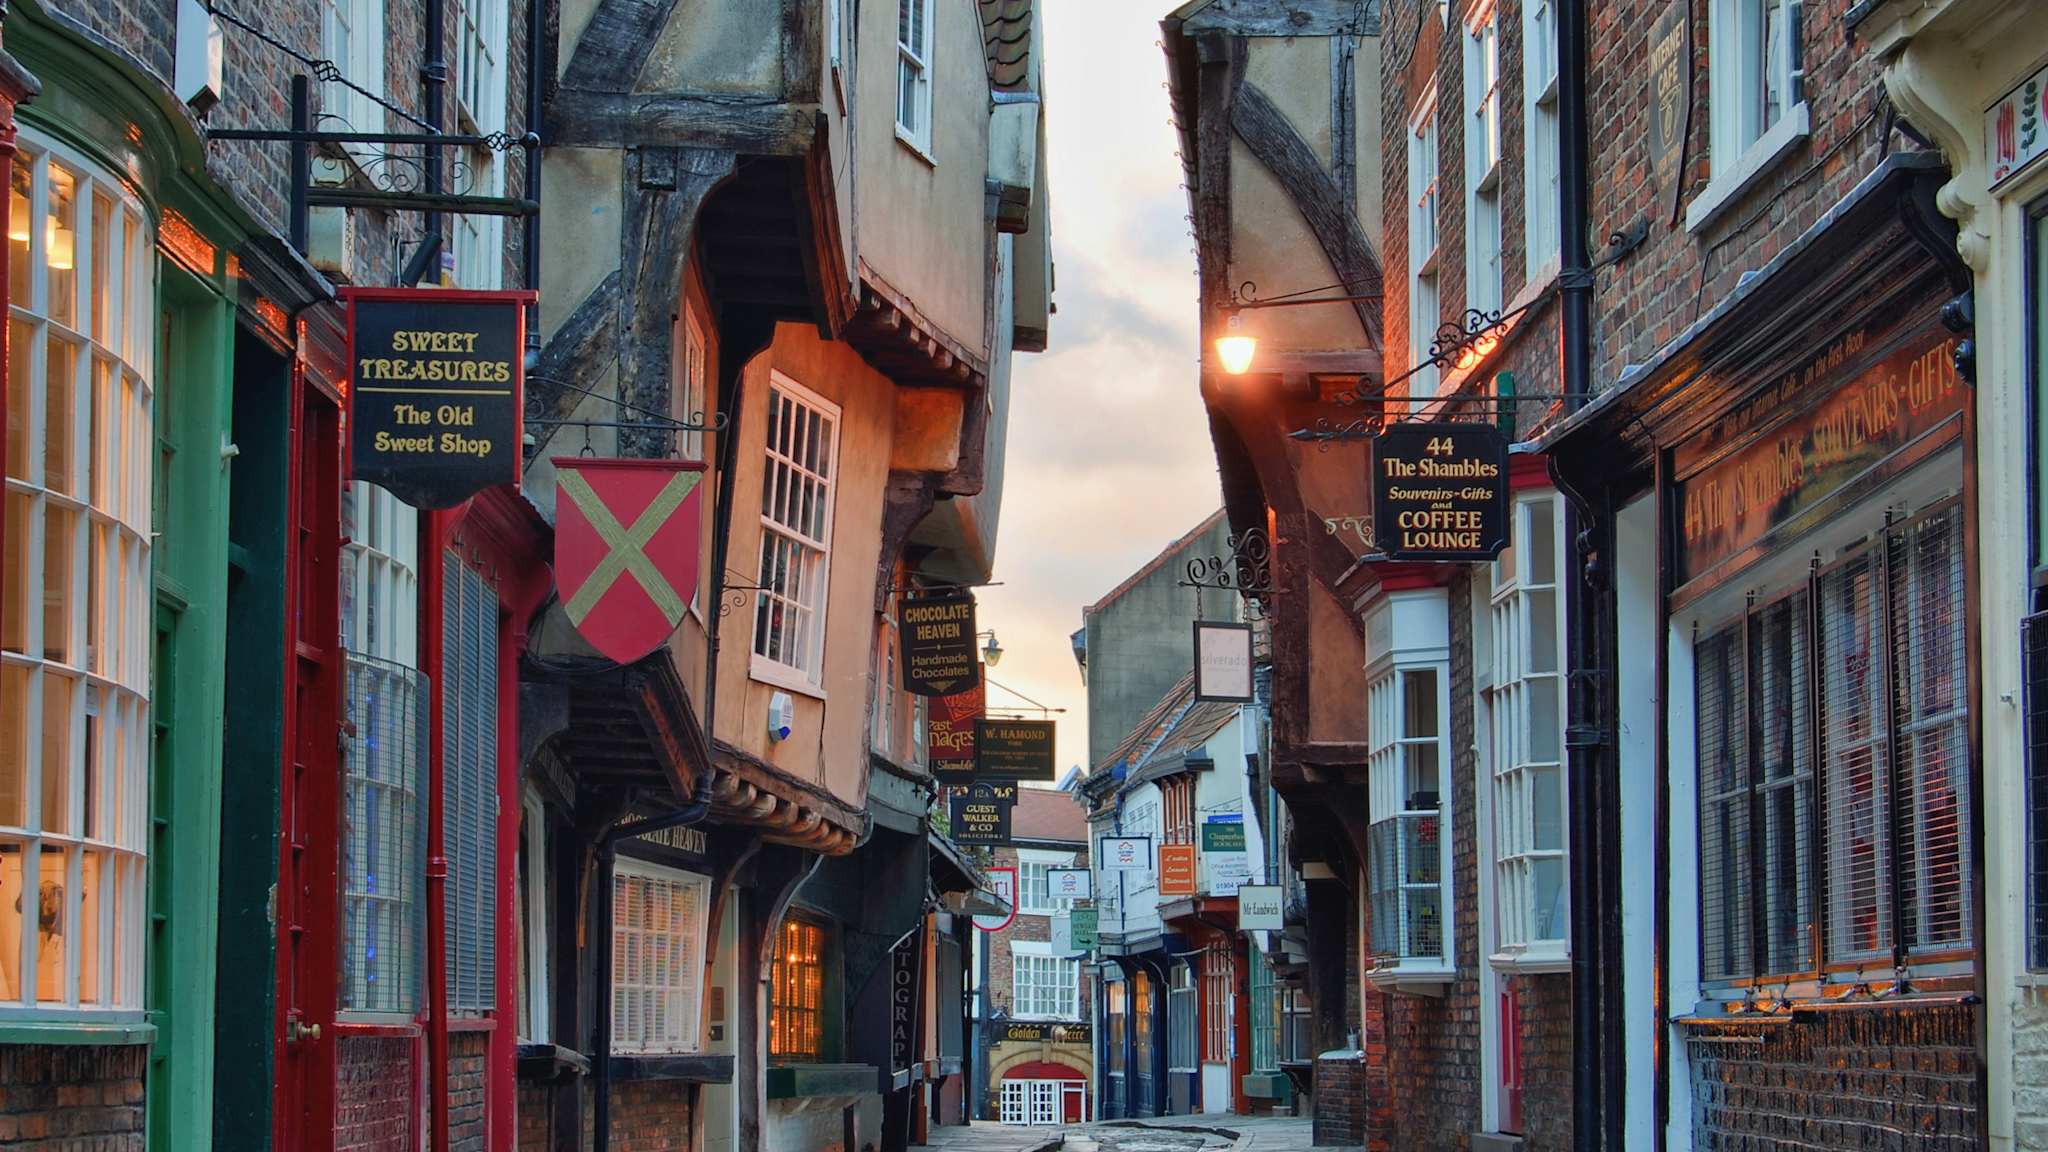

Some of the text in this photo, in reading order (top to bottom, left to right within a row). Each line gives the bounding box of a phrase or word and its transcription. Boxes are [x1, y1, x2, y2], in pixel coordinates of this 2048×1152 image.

[1650, 18, 1685, 78] INTERNET
[392, 330, 479, 353] SWEET
[360, 358, 511, 382] TREASURES
[1804, 366, 1814, 385] on
[1816, 356, 1826, 378] the
[393, 404, 473, 426] The Old
[374, 431, 491, 457] Sweet Shop
[1426, 437, 1454, 456] 44
[1383, 458, 1498, 477] The Shambles
[1684, 490, 1702, 541] 44
[1705, 480, 1729, 530] The
[1736, 435, 1804, 517] Shambles
[1398, 511, 1482, 529] COFFEE
[1404, 531, 1481, 548] LOUNGE
[905, 604, 969, 623] CHOCOLATE
[917, 623, 960, 641] HEAVEN
[911, 653, 968, 666] Handmade
[1200, 655, 1248, 666] silverado
[912, 666, 969, 679] Chocolates
[929, 730, 975, 752] mages
[1000, 729, 1045, 740] HAMOND
[962, 813, 1000, 823] WALKER
[966, 804, 997, 813] GUEST
[969, 823, 993, 832] & CO
[672, 826, 707, 856] HEAVEN
[1008, 1027, 1040, 1040] Golden
